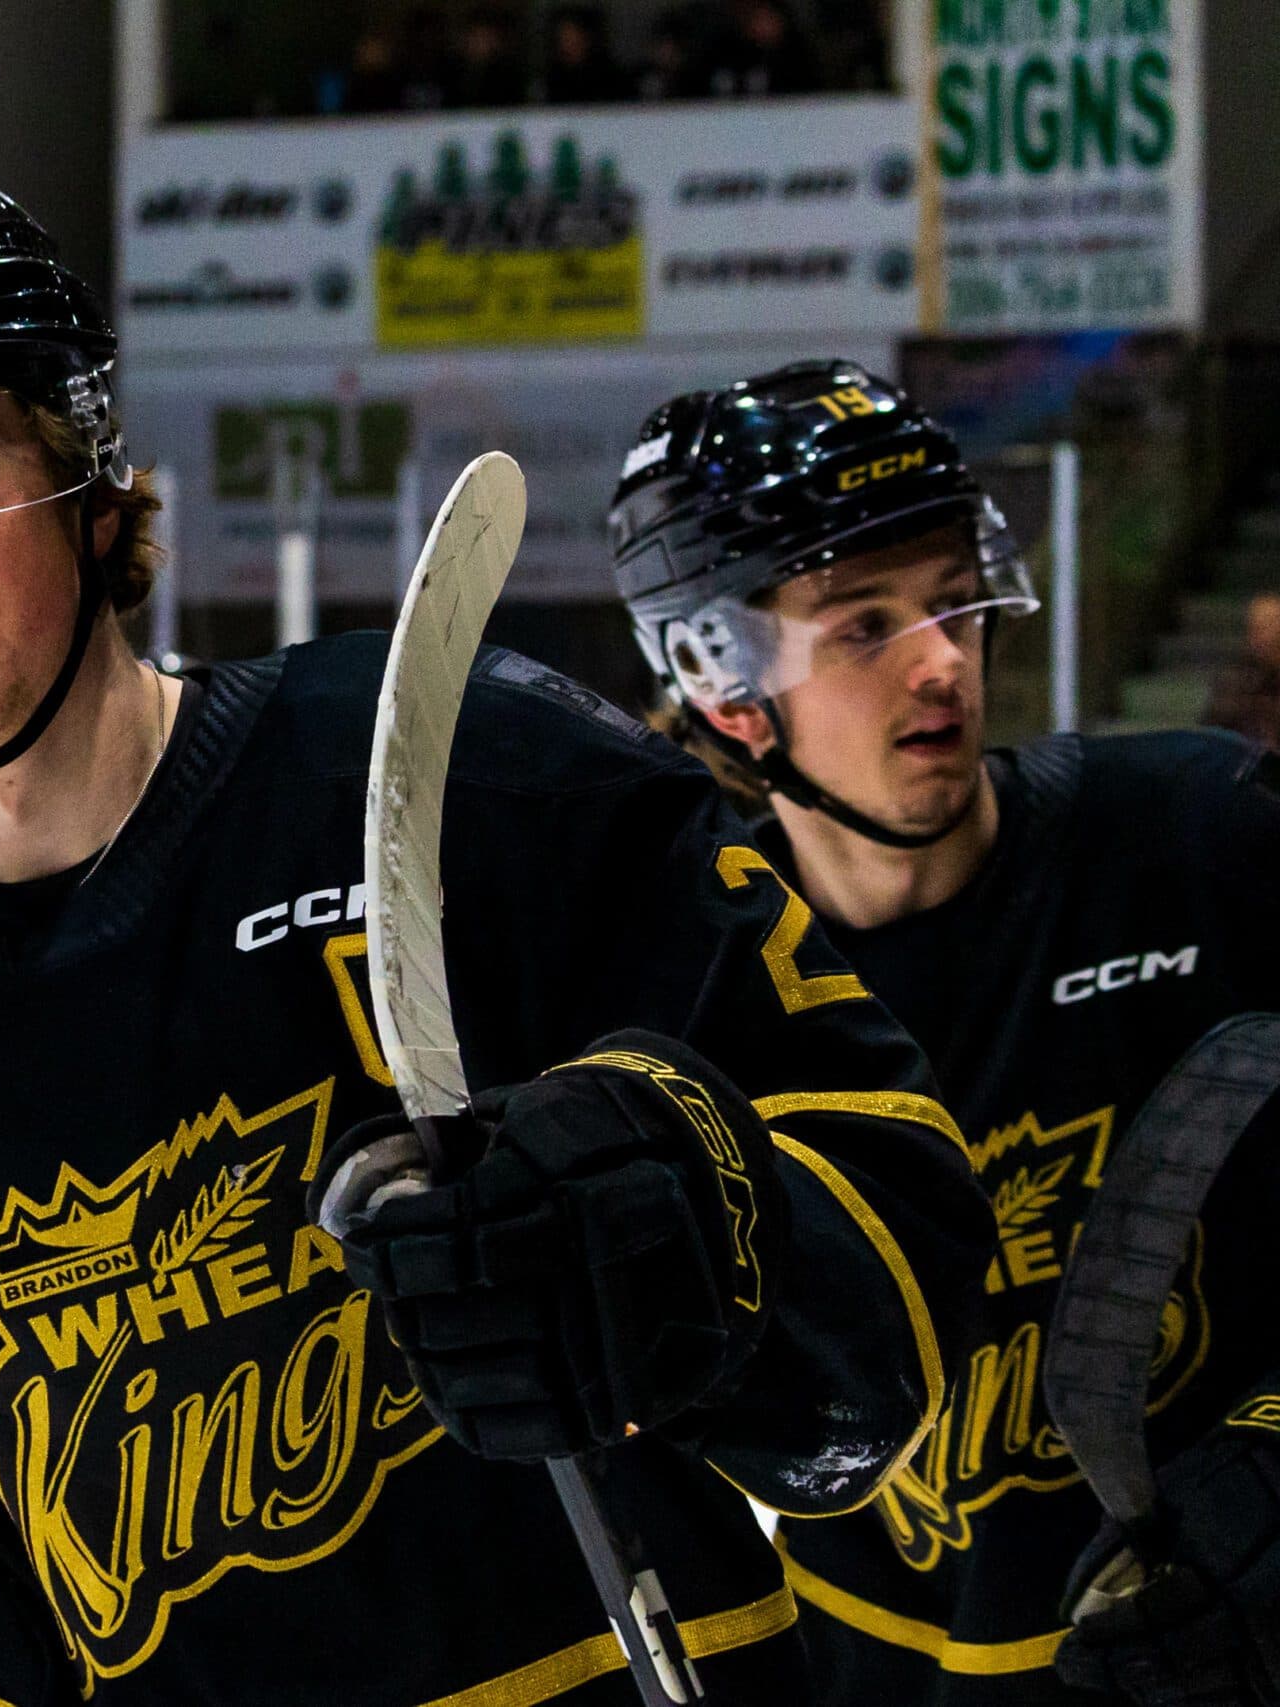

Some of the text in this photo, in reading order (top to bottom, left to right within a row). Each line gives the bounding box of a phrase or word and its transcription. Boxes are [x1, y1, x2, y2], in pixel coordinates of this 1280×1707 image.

[936, 48, 1175, 178] SIGNS
[818, 386, 876, 421] 19
[838, 447, 926, 491] CCM
[1052, 945, 1199, 1004] CCM
[5, 1248, 133, 1303] BRANDON
[29, 1224, 345, 1371] WHEA
[12, 1289, 423, 1660] King
